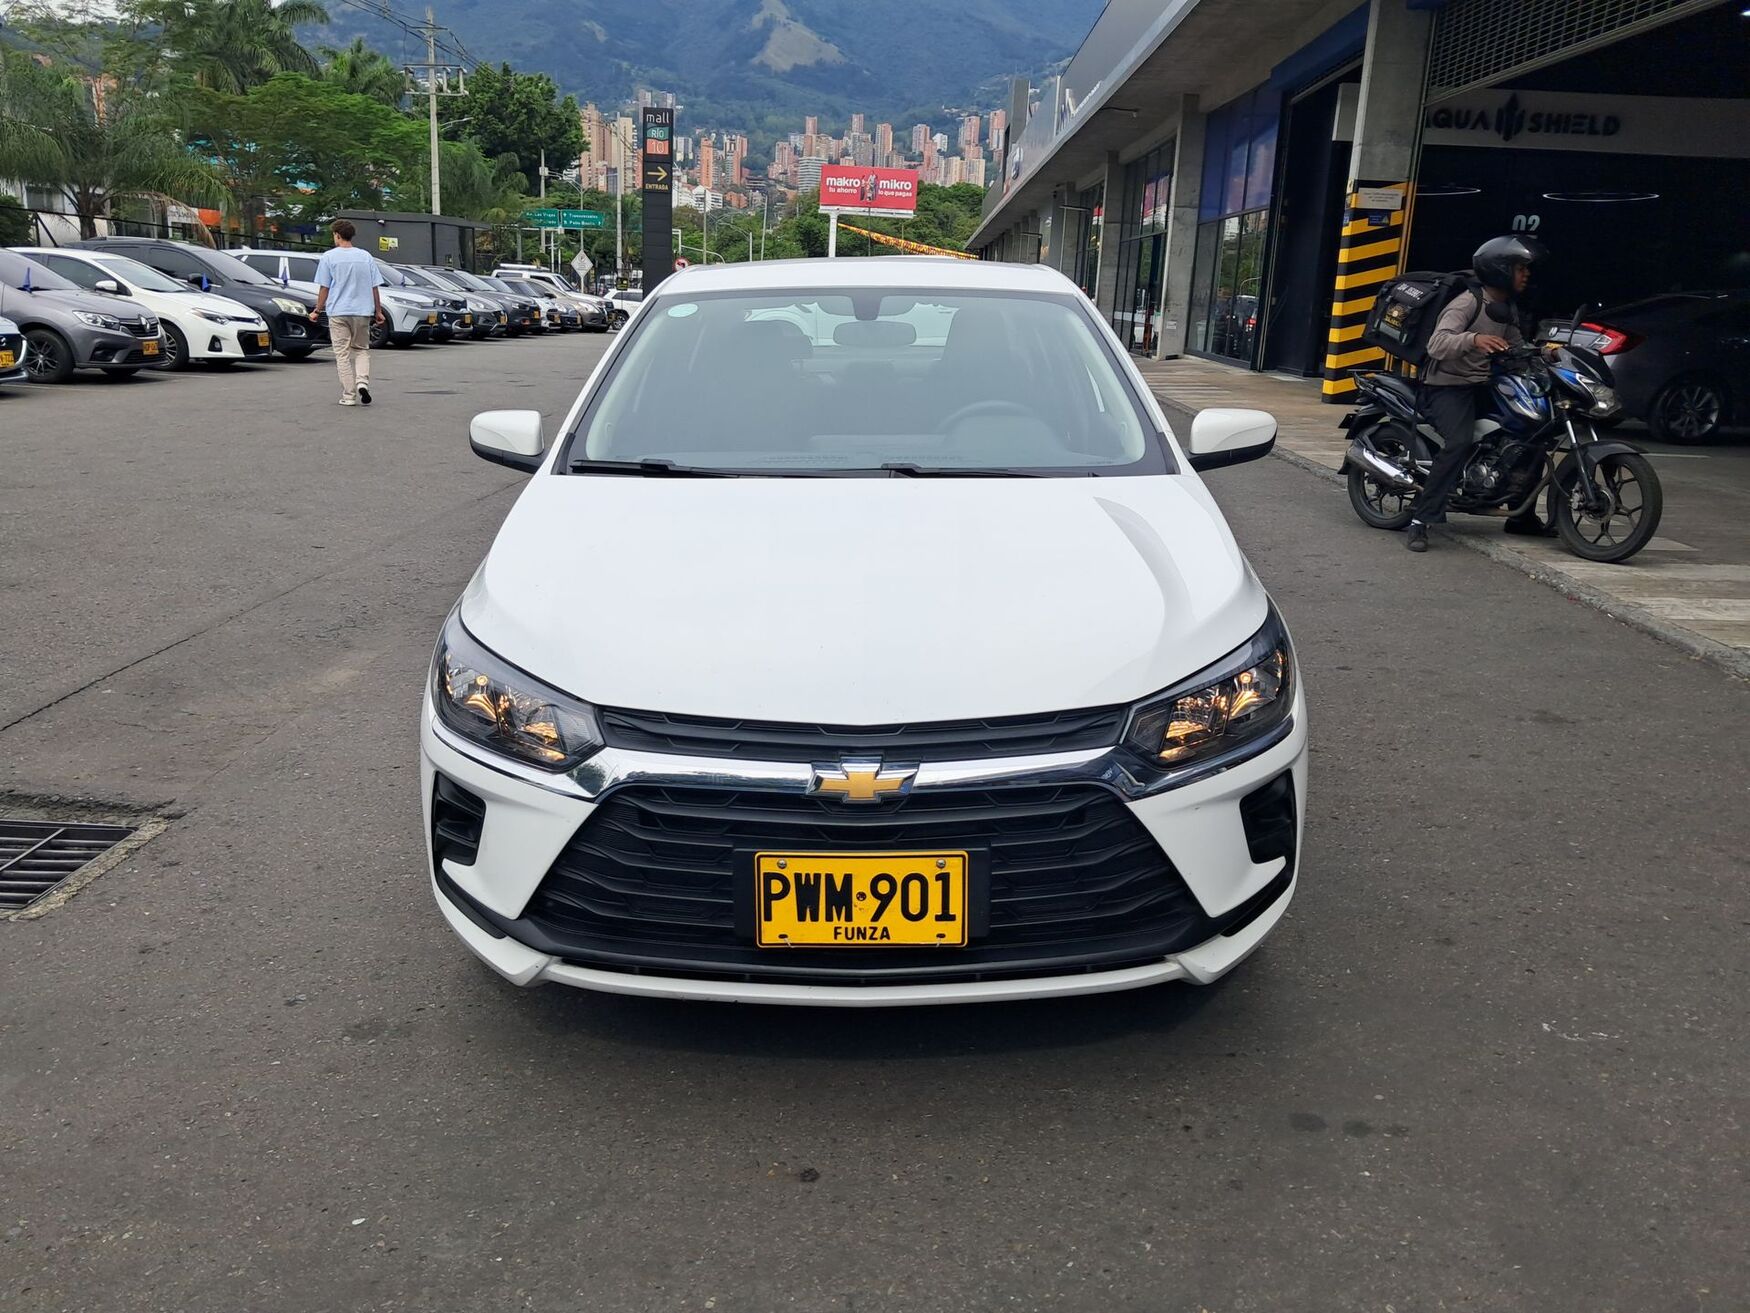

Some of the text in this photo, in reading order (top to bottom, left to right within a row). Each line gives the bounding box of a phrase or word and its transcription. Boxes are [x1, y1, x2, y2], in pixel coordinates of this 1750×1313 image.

[646, 112, 669, 123] mall
[1527, 112, 1621, 136] SHIELD
[652, 141, 664, 153] 10
[826, 177, 912, 190] makro mikro
[834, 926, 890, 940] FUNZA
